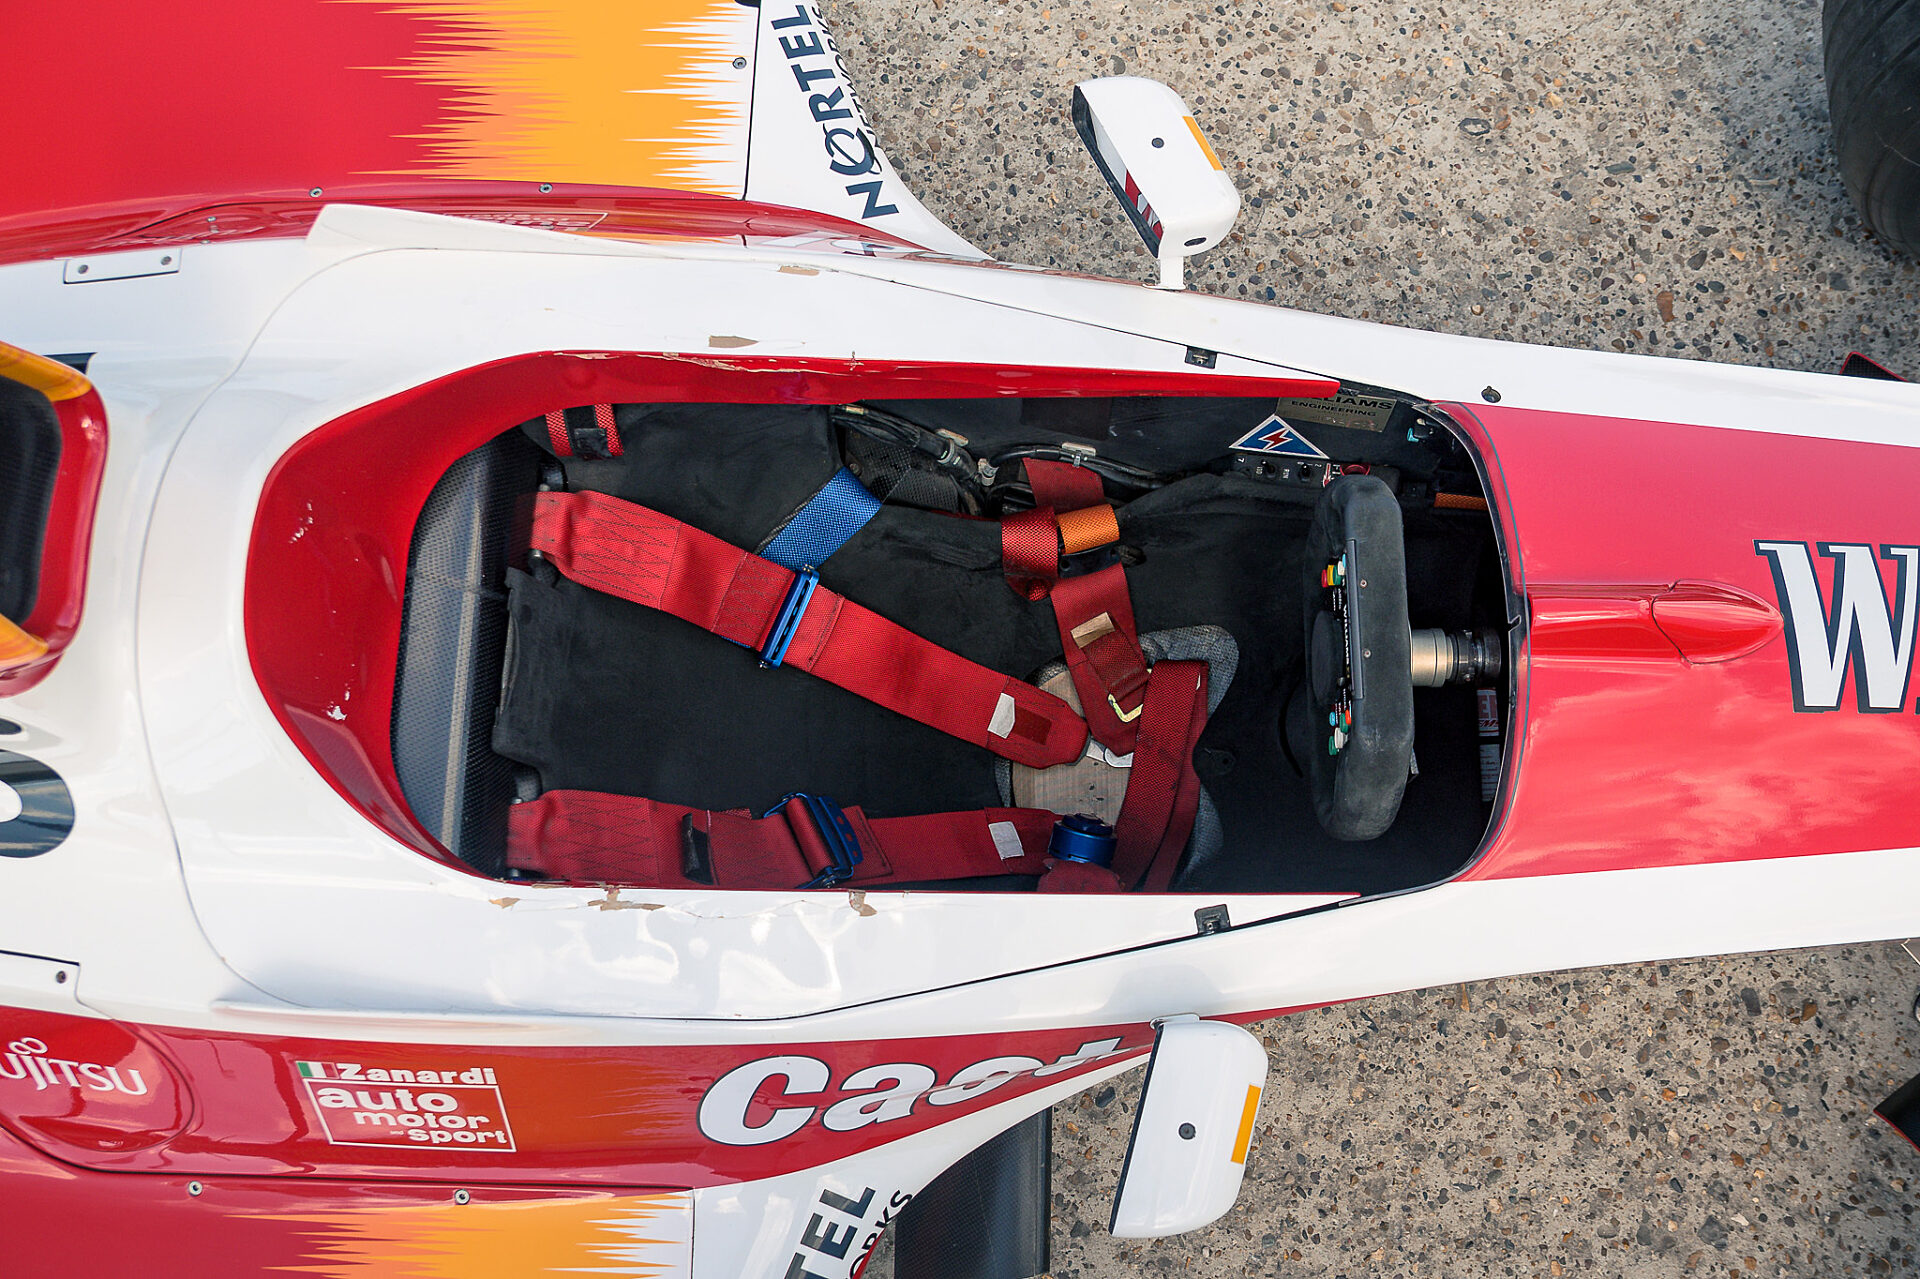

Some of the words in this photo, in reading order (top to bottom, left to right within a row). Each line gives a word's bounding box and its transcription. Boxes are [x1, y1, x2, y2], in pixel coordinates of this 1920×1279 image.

[1291, 400, 1377, 417] ENGINEERING
[335, 1062, 498, 1085] Zanardi
[317, 1087, 458, 1113] auto
[353, 1111, 490, 1129] motor
[407, 1128, 508, 1144] sport
